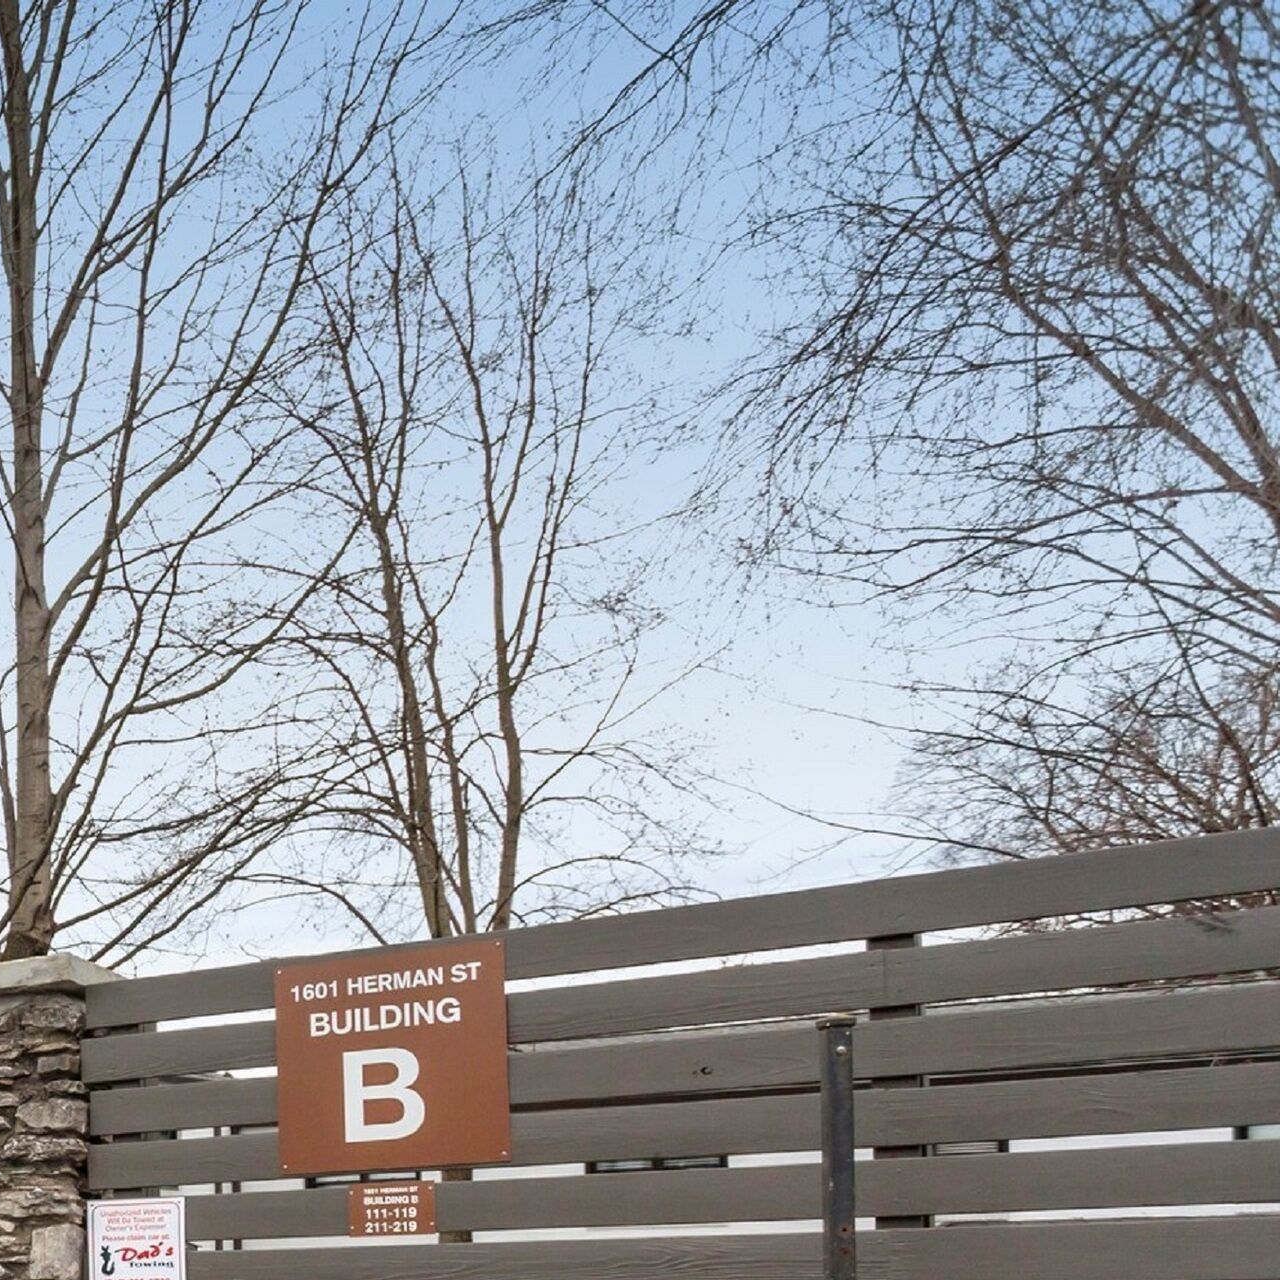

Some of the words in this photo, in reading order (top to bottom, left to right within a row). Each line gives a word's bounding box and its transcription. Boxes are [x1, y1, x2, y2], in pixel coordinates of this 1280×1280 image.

[290, 981, 338, 1002] 1601
[347, 966, 443, 995] HERMAN
[450, 962, 482, 983] ST
[309, 997, 461, 1037] BUILDING
[342, 1047, 426, 1143] B
[363, 1196, 409, 1205] BUILDING
[366, 1207, 417, 1219] 111-119
[365, 1221, 417, 1233] 211-219
[115, 1242, 174, 1262] Dad's
